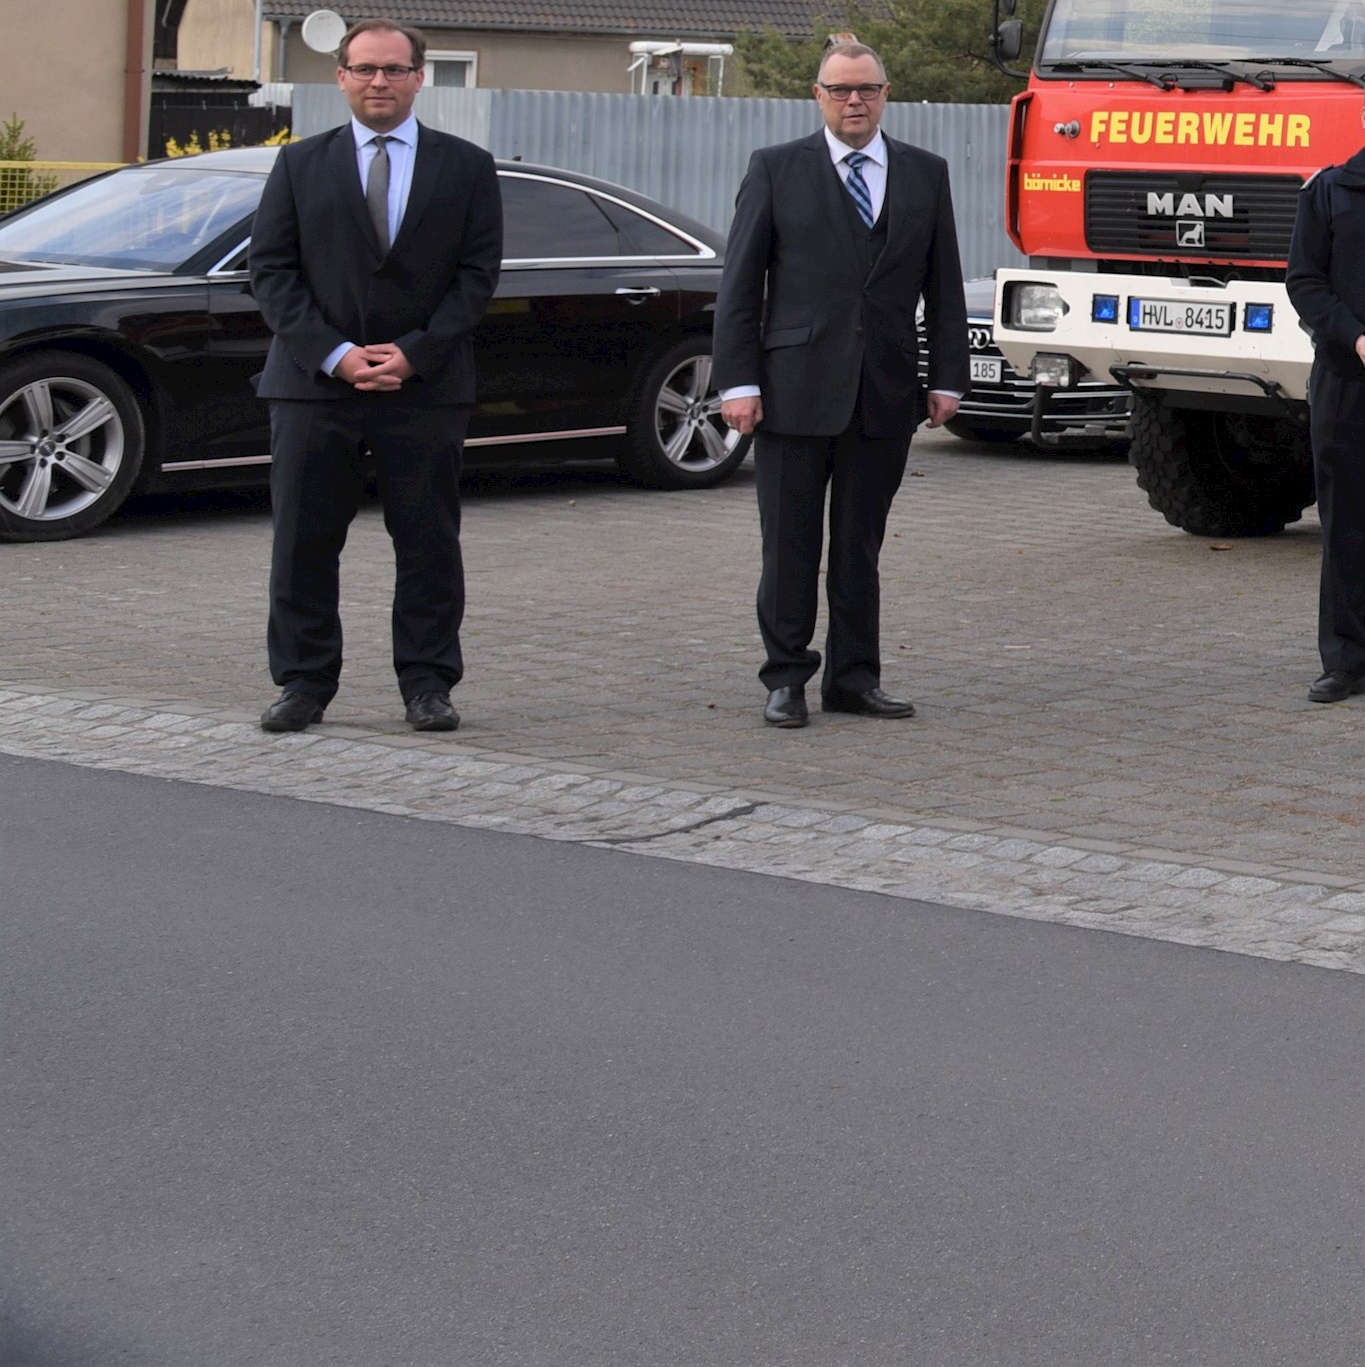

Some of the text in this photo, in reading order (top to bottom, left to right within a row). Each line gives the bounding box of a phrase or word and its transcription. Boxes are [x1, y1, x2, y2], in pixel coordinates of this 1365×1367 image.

[1090, 111, 1311, 147] FEUERWEHR
[1147, 192, 1233, 218] MAN
[1142, 307, 1174, 327] HVL
[1184, 308, 1225, 330] 8415
[973, 362, 996, 379] 185
